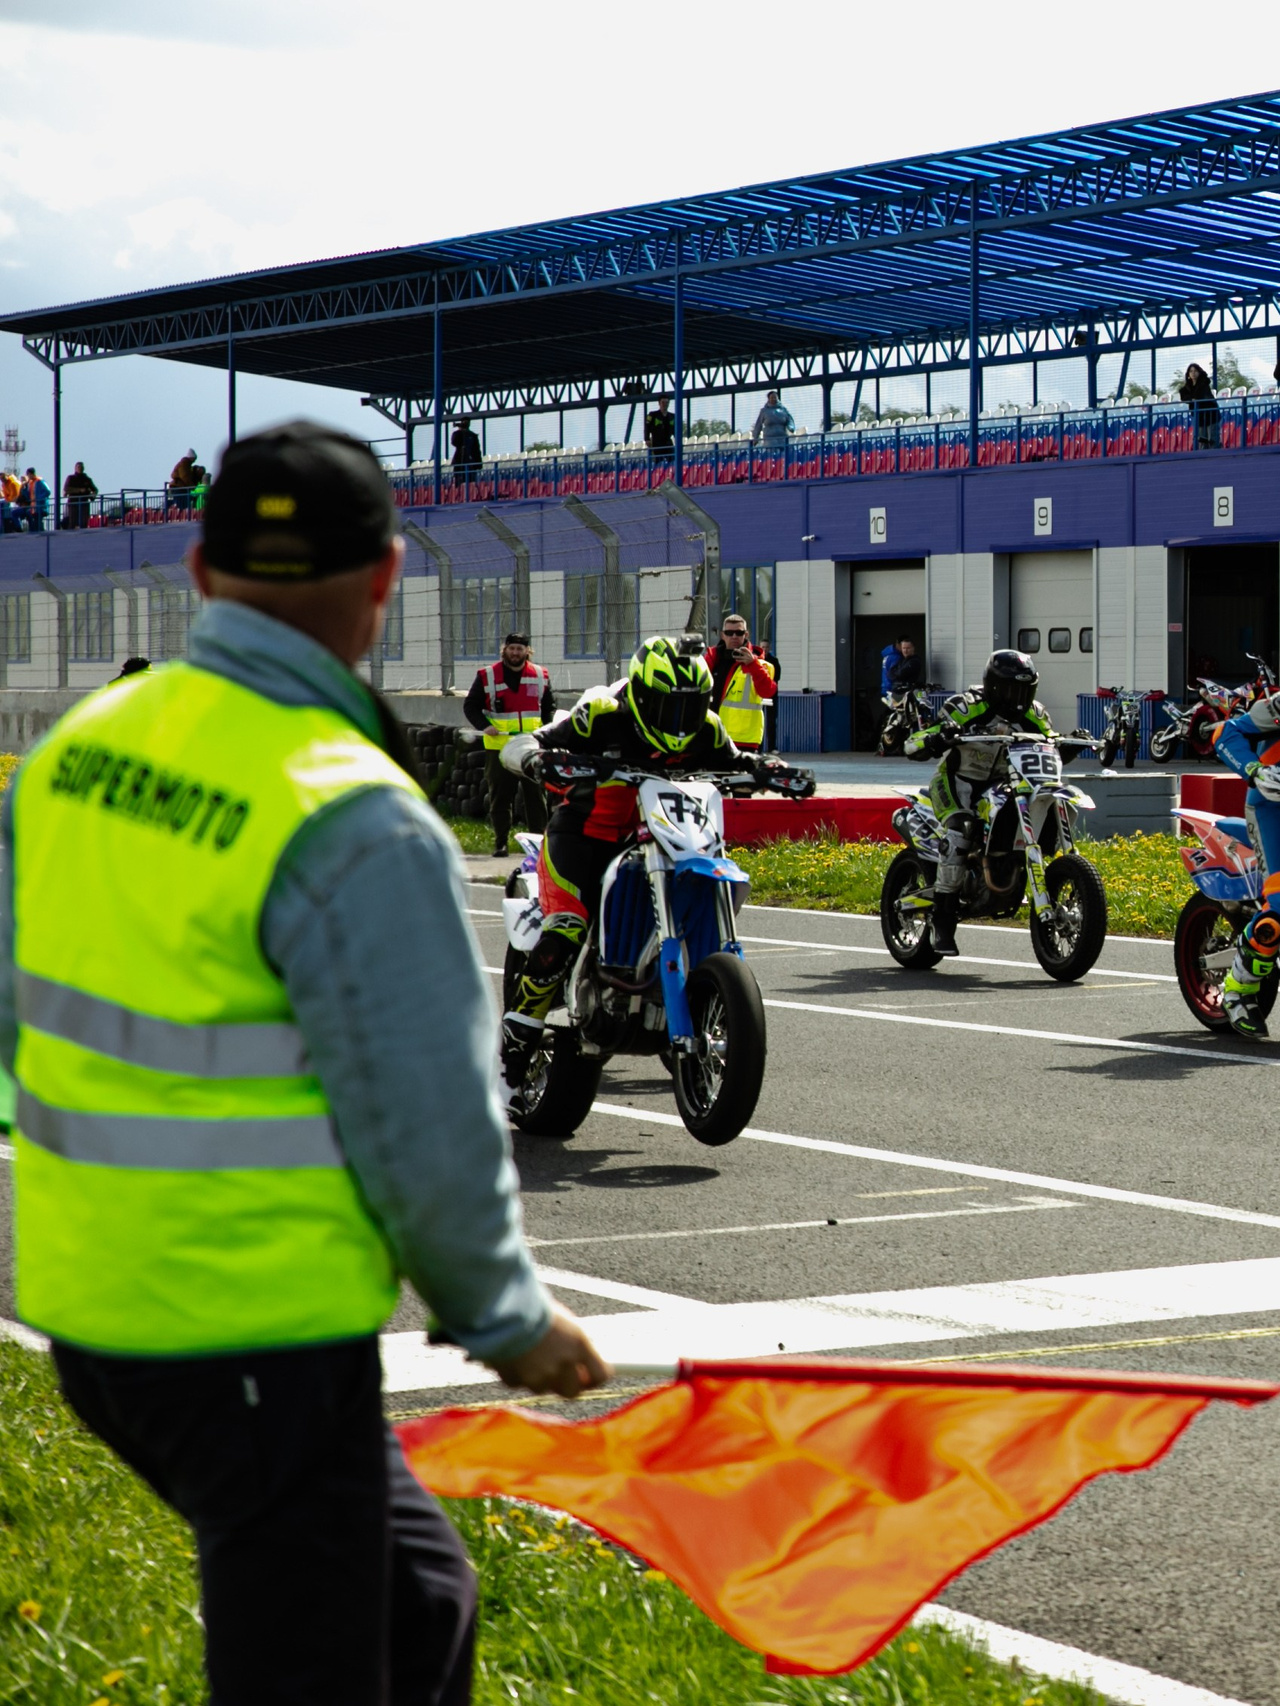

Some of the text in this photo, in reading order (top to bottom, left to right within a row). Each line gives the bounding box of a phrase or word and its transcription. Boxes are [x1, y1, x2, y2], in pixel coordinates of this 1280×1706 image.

[1037, 506, 1049, 527] 9
[1217, 495, 1230, 518] 8
[870, 515, 886, 536] 10
[1020, 753, 1058, 776] 26
[50, 742, 251, 852] SUPERMOTO
[1189, 850, 1209, 868] 14
